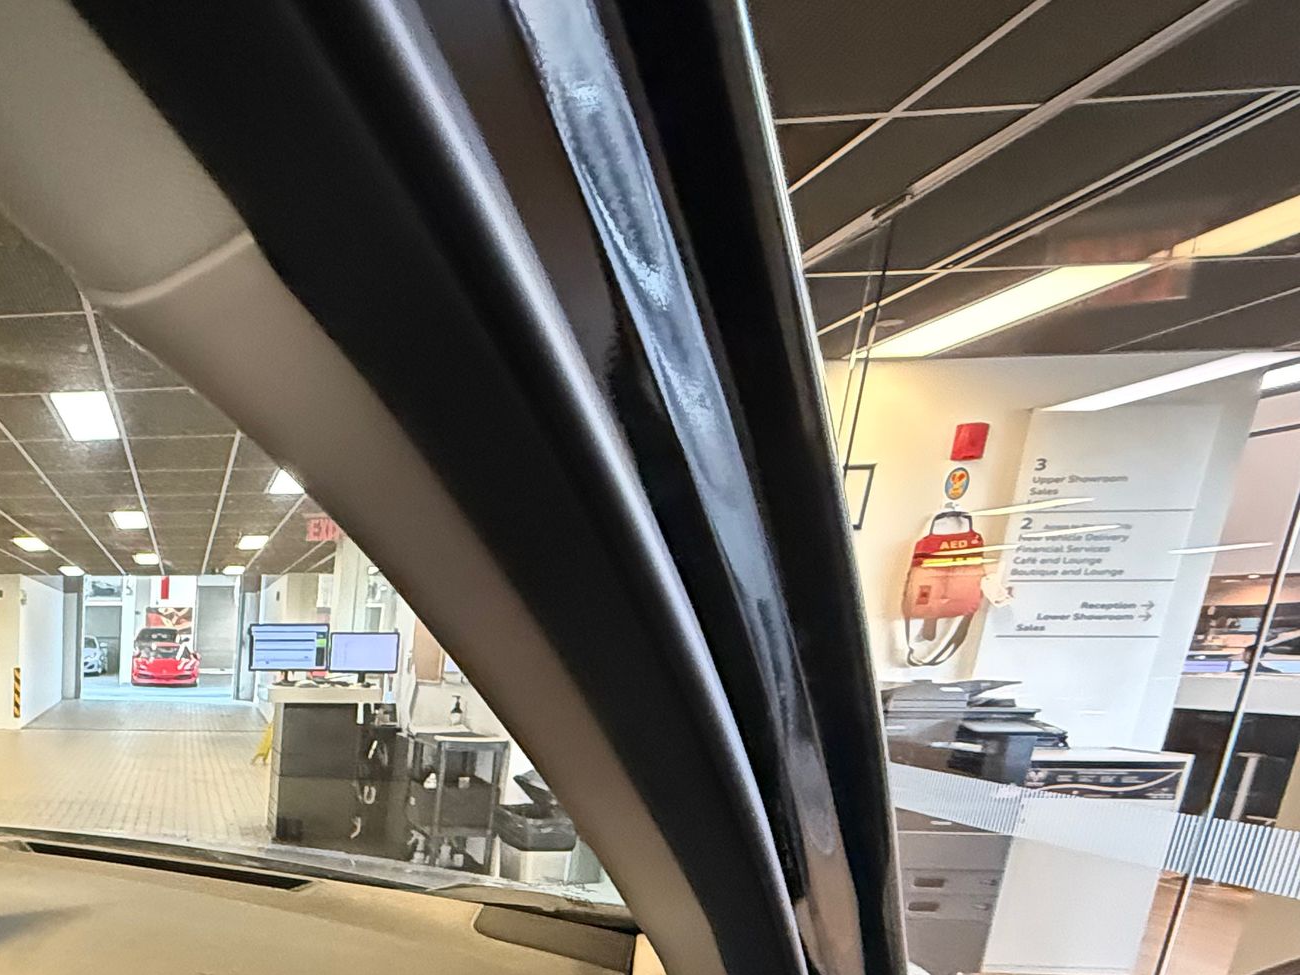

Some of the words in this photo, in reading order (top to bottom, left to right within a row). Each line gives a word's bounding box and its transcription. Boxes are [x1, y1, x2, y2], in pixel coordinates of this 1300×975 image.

[1034, 458, 1047, 471] 3
[1032, 475, 1065, 485] Upper
[1067, 474, 1129, 484] Showroom
[1029, 487, 1059, 496] Sales
[1020, 517, 1033, 530] 2
[1084, 533, 1130, 543] Delivery
[940, 540, 968, 550] AED
[1015, 545, 1064, 553] Financial
[1066, 545, 1111, 553] Services
[1039, 556, 1061, 565] and
[1062, 556, 1103, 566] Lounge
[1010, 568, 1059, 577] Boutique
[1060, 568, 1082, 576] and
[1083, 568, 1125, 577] Lounge
[1080, 601, 1137, 611] Reception
[1036, 612, 1071, 621] Lower
[1072, 612, 1135, 621] Showroom
[1015, 623, 1046, 632] Sales
